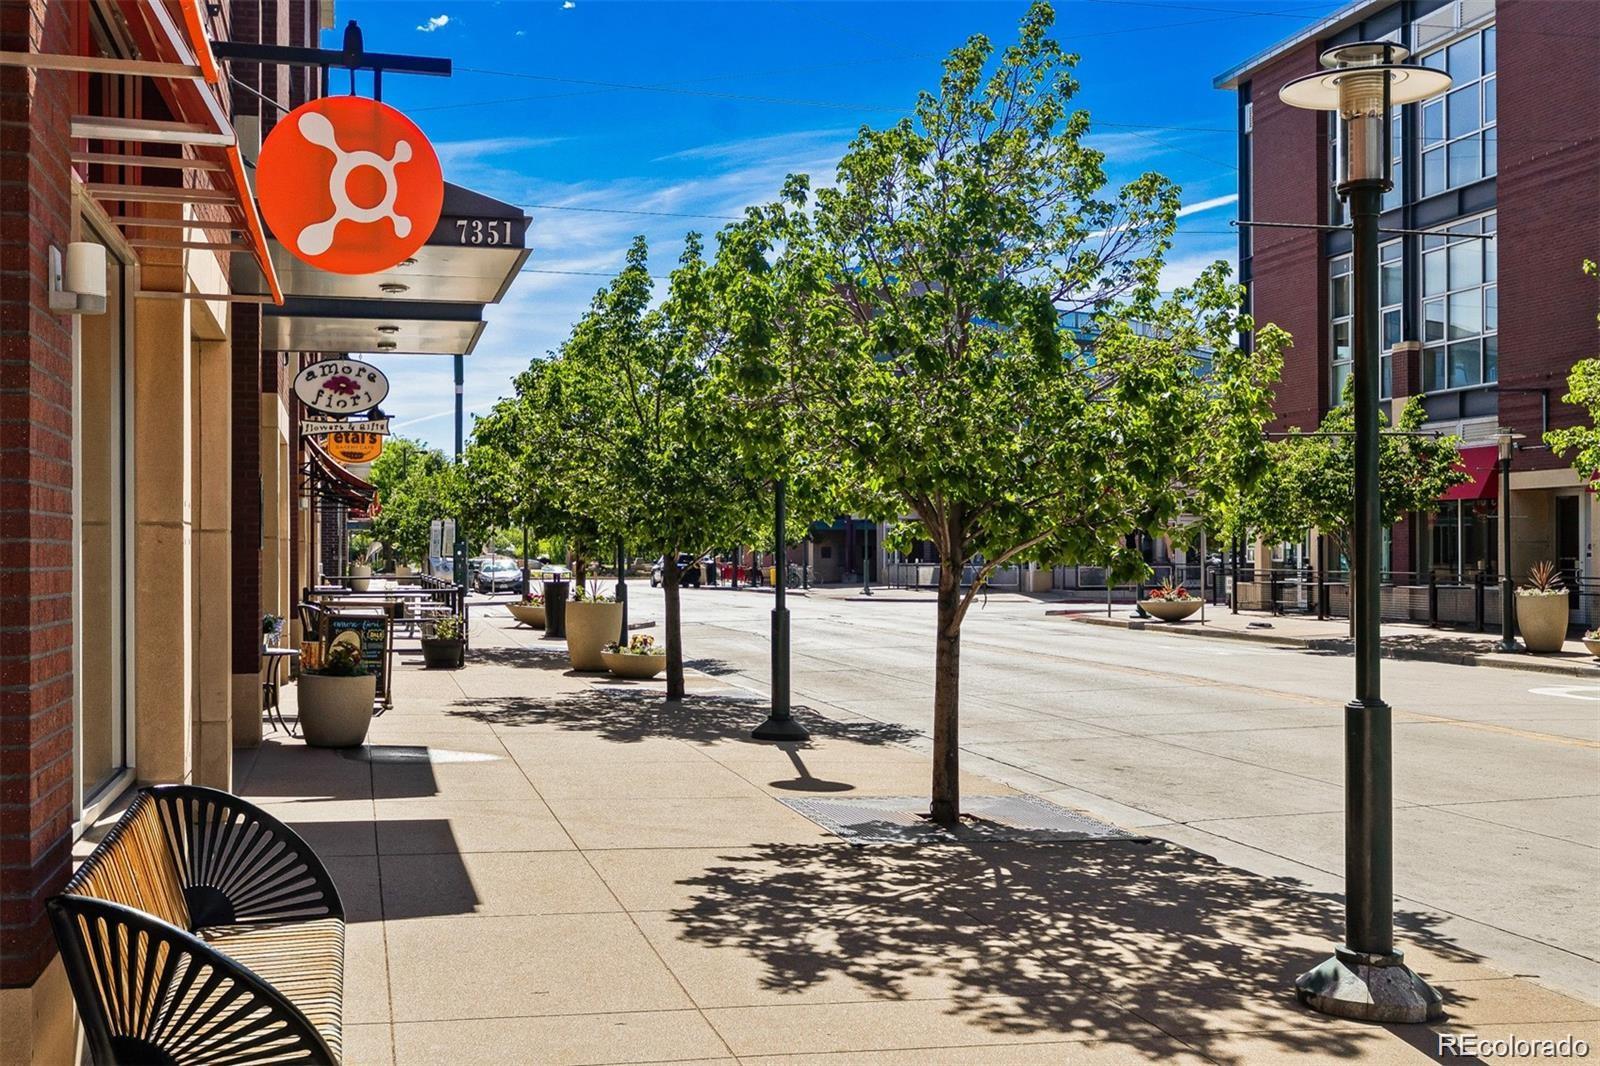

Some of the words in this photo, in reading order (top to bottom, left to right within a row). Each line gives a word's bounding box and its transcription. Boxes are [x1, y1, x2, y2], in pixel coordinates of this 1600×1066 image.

[456, 220, 512, 245] 7351
[305, 363, 377, 383] amore
[312, 389, 372, 408] fiori
[305, 424, 344, 432] flowers
